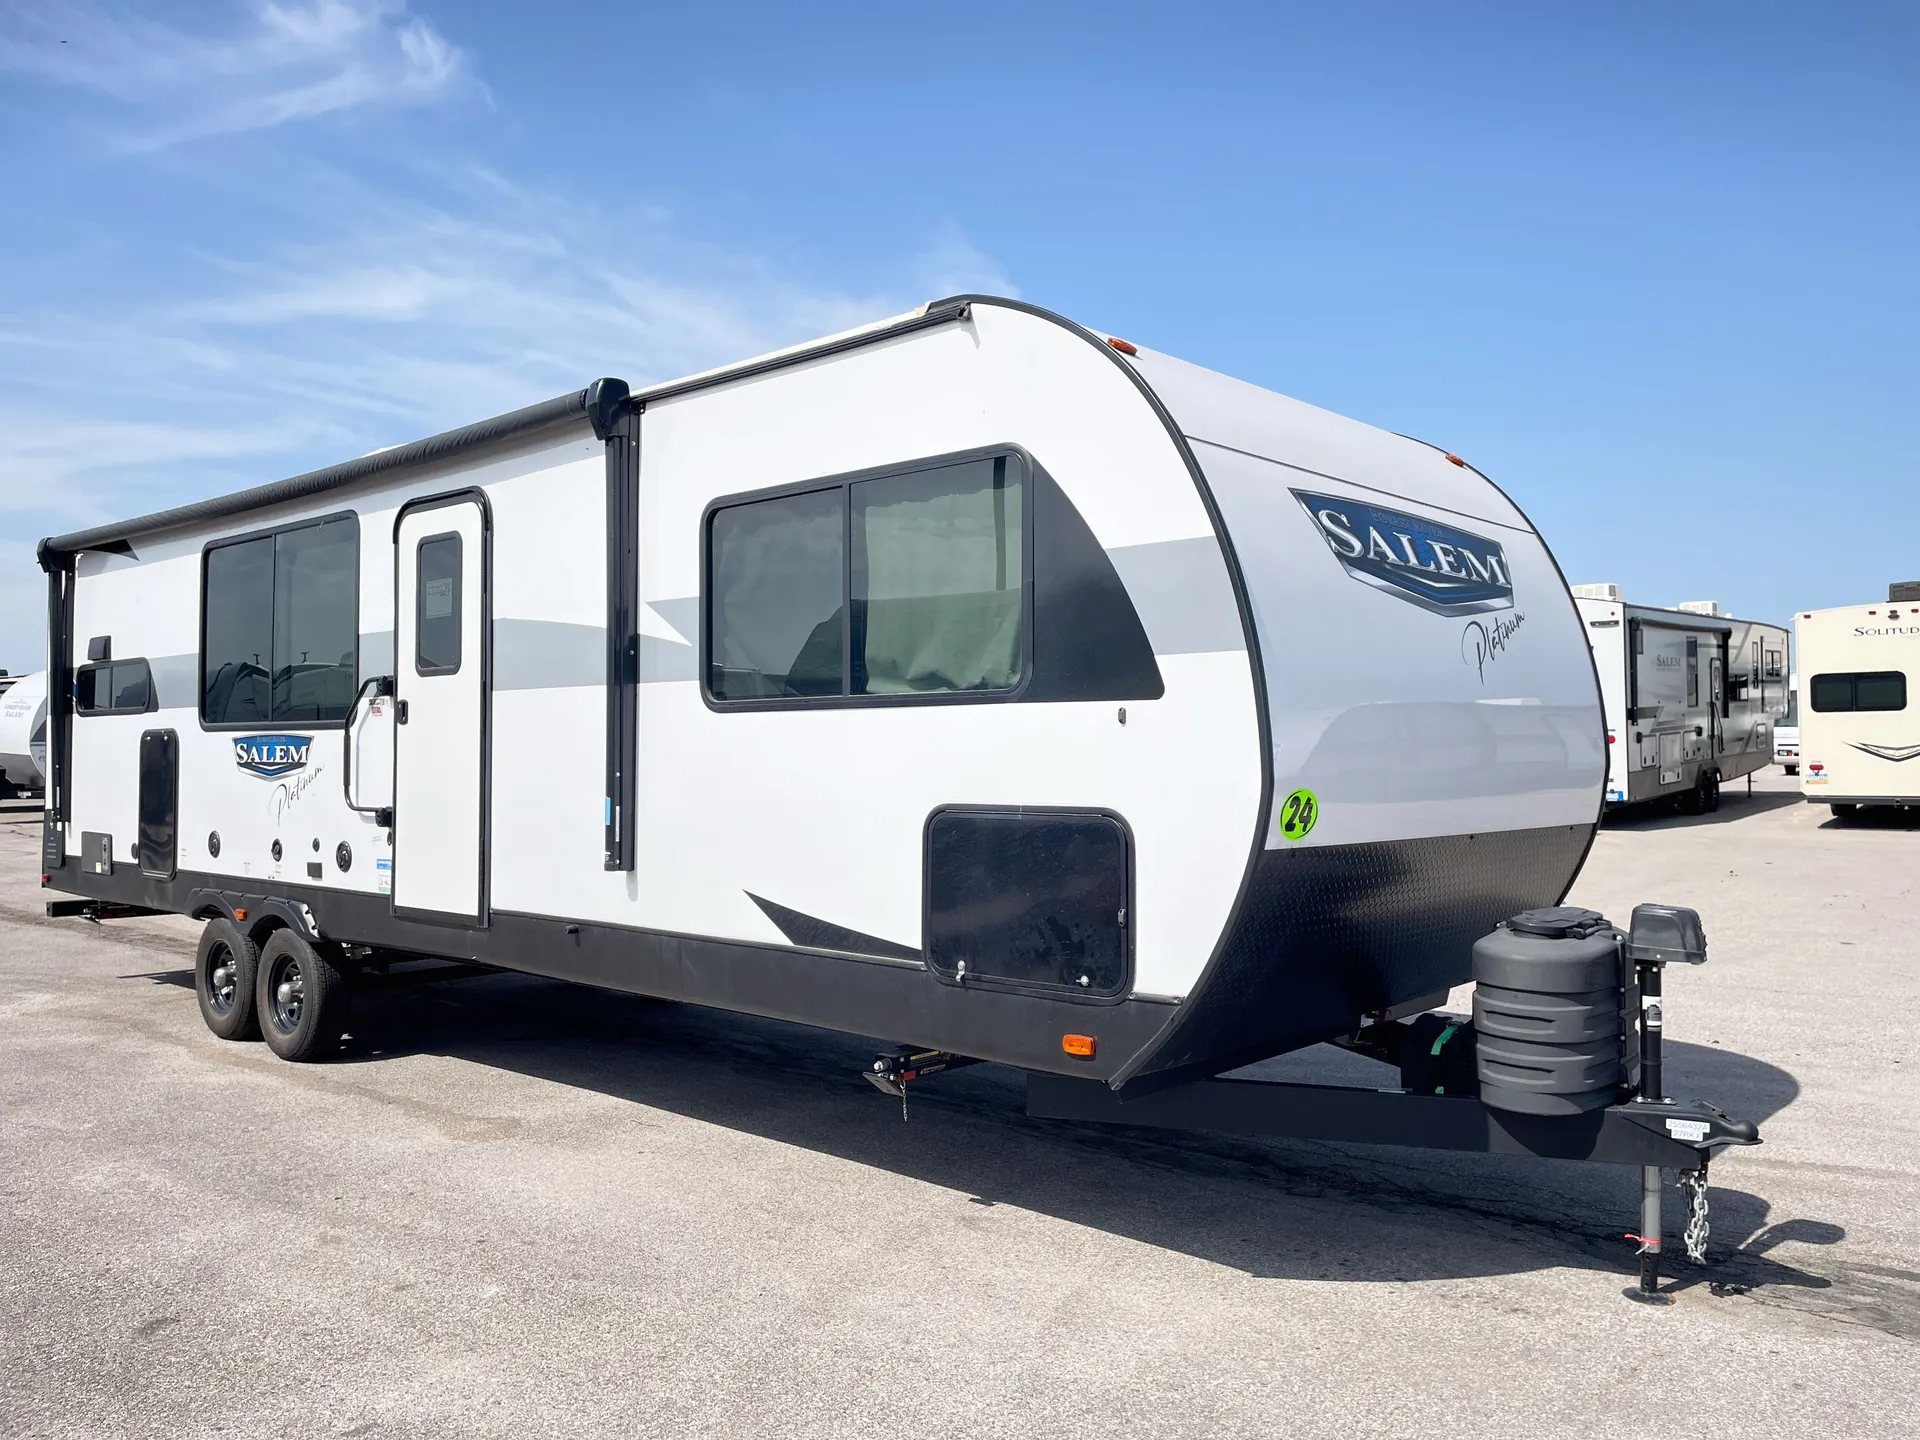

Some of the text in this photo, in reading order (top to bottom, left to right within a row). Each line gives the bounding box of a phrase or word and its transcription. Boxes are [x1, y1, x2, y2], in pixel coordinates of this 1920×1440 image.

[1317, 508, 1513, 589] SALEM
[1461, 611, 1526, 686] Platinum
[236, 743, 308, 764] SALEM
[268, 763, 325, 828] Platinum
[1284, 795, 1314, 833] 24
